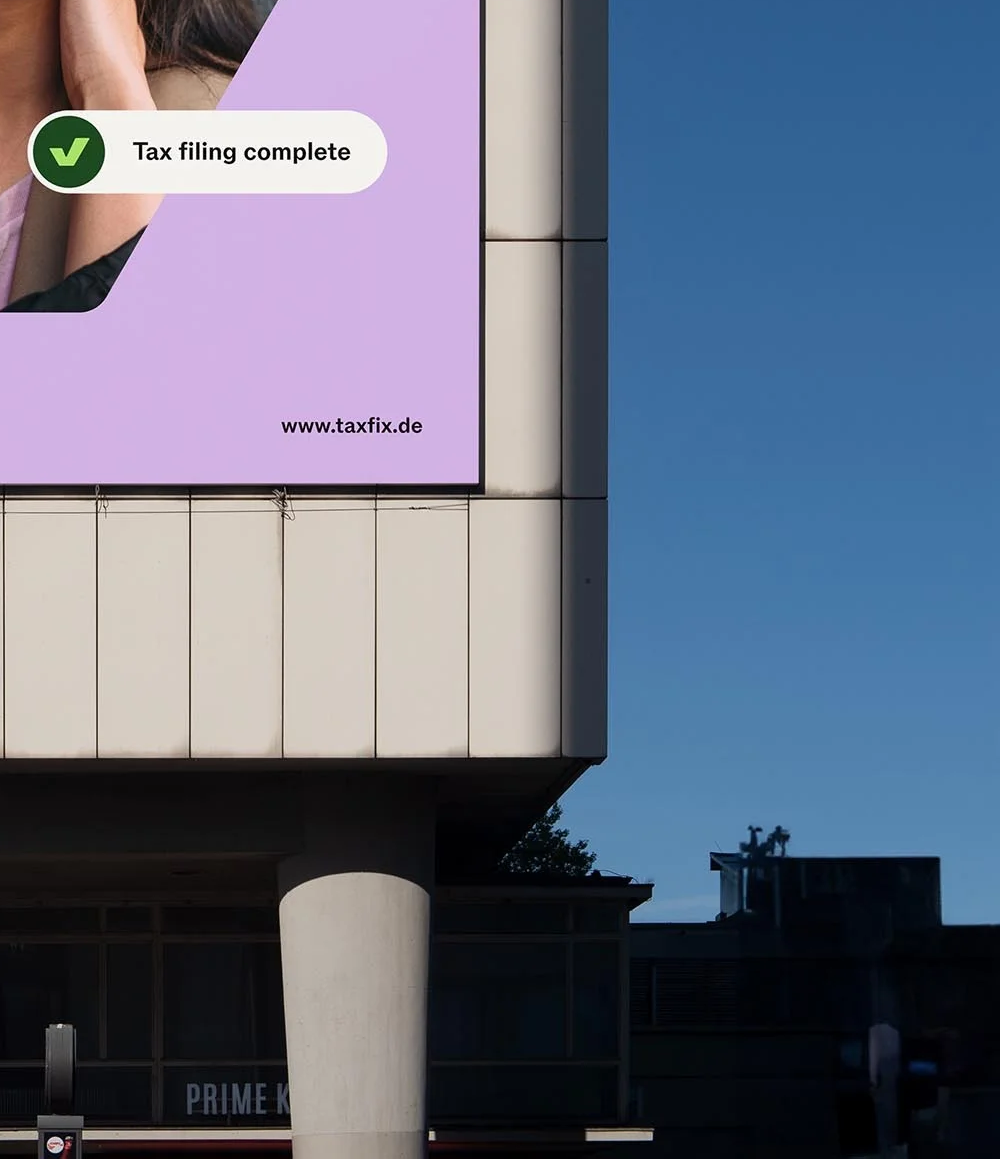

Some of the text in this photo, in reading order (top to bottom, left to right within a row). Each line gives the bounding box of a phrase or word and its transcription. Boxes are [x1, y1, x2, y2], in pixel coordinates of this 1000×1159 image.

[132, 141, 351, 165] Tax filing complete
[280, 416, 423, 434] www.taxfix.de
[186, 1082, 267, 1115] PRIME
